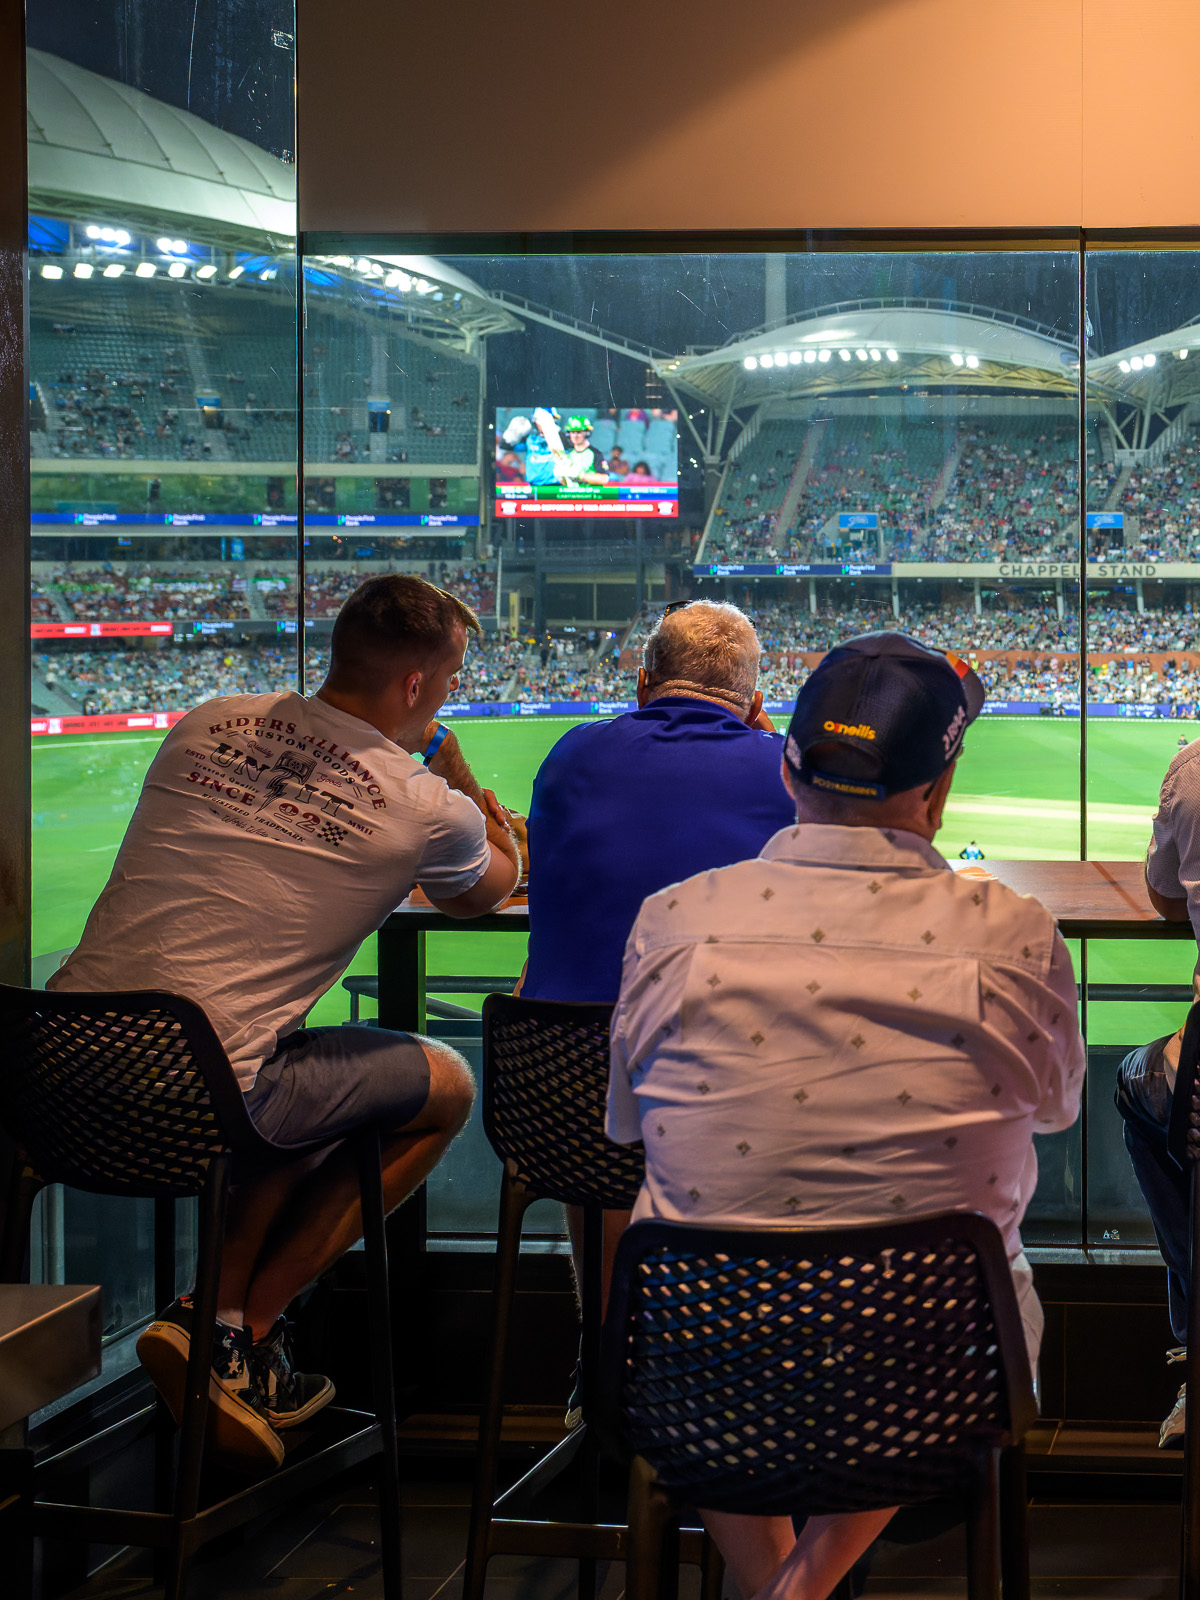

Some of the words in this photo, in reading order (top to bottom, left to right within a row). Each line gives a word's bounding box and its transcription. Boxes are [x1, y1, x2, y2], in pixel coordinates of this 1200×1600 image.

[999, 564, 1088, 576] CHAPPEL
[1099, 564, 1157, 577] STAND
[184, 748, 206, 760] ESTD
[209, 717, 297, 735] RIDERS
[303, 735, 387, 810] ALLIANCE
[243, 728, 306, 751] CUSTOM
[312, 749, 356, 785] GOODS
[186, 771, 256, 806] SINCE
[194, 762, 226, 778] Trusted
[228, 777, 260, 793] Quality
[254, 816, 306, 842] TRADEMARK
[347, 820, 374, 836] MMII
